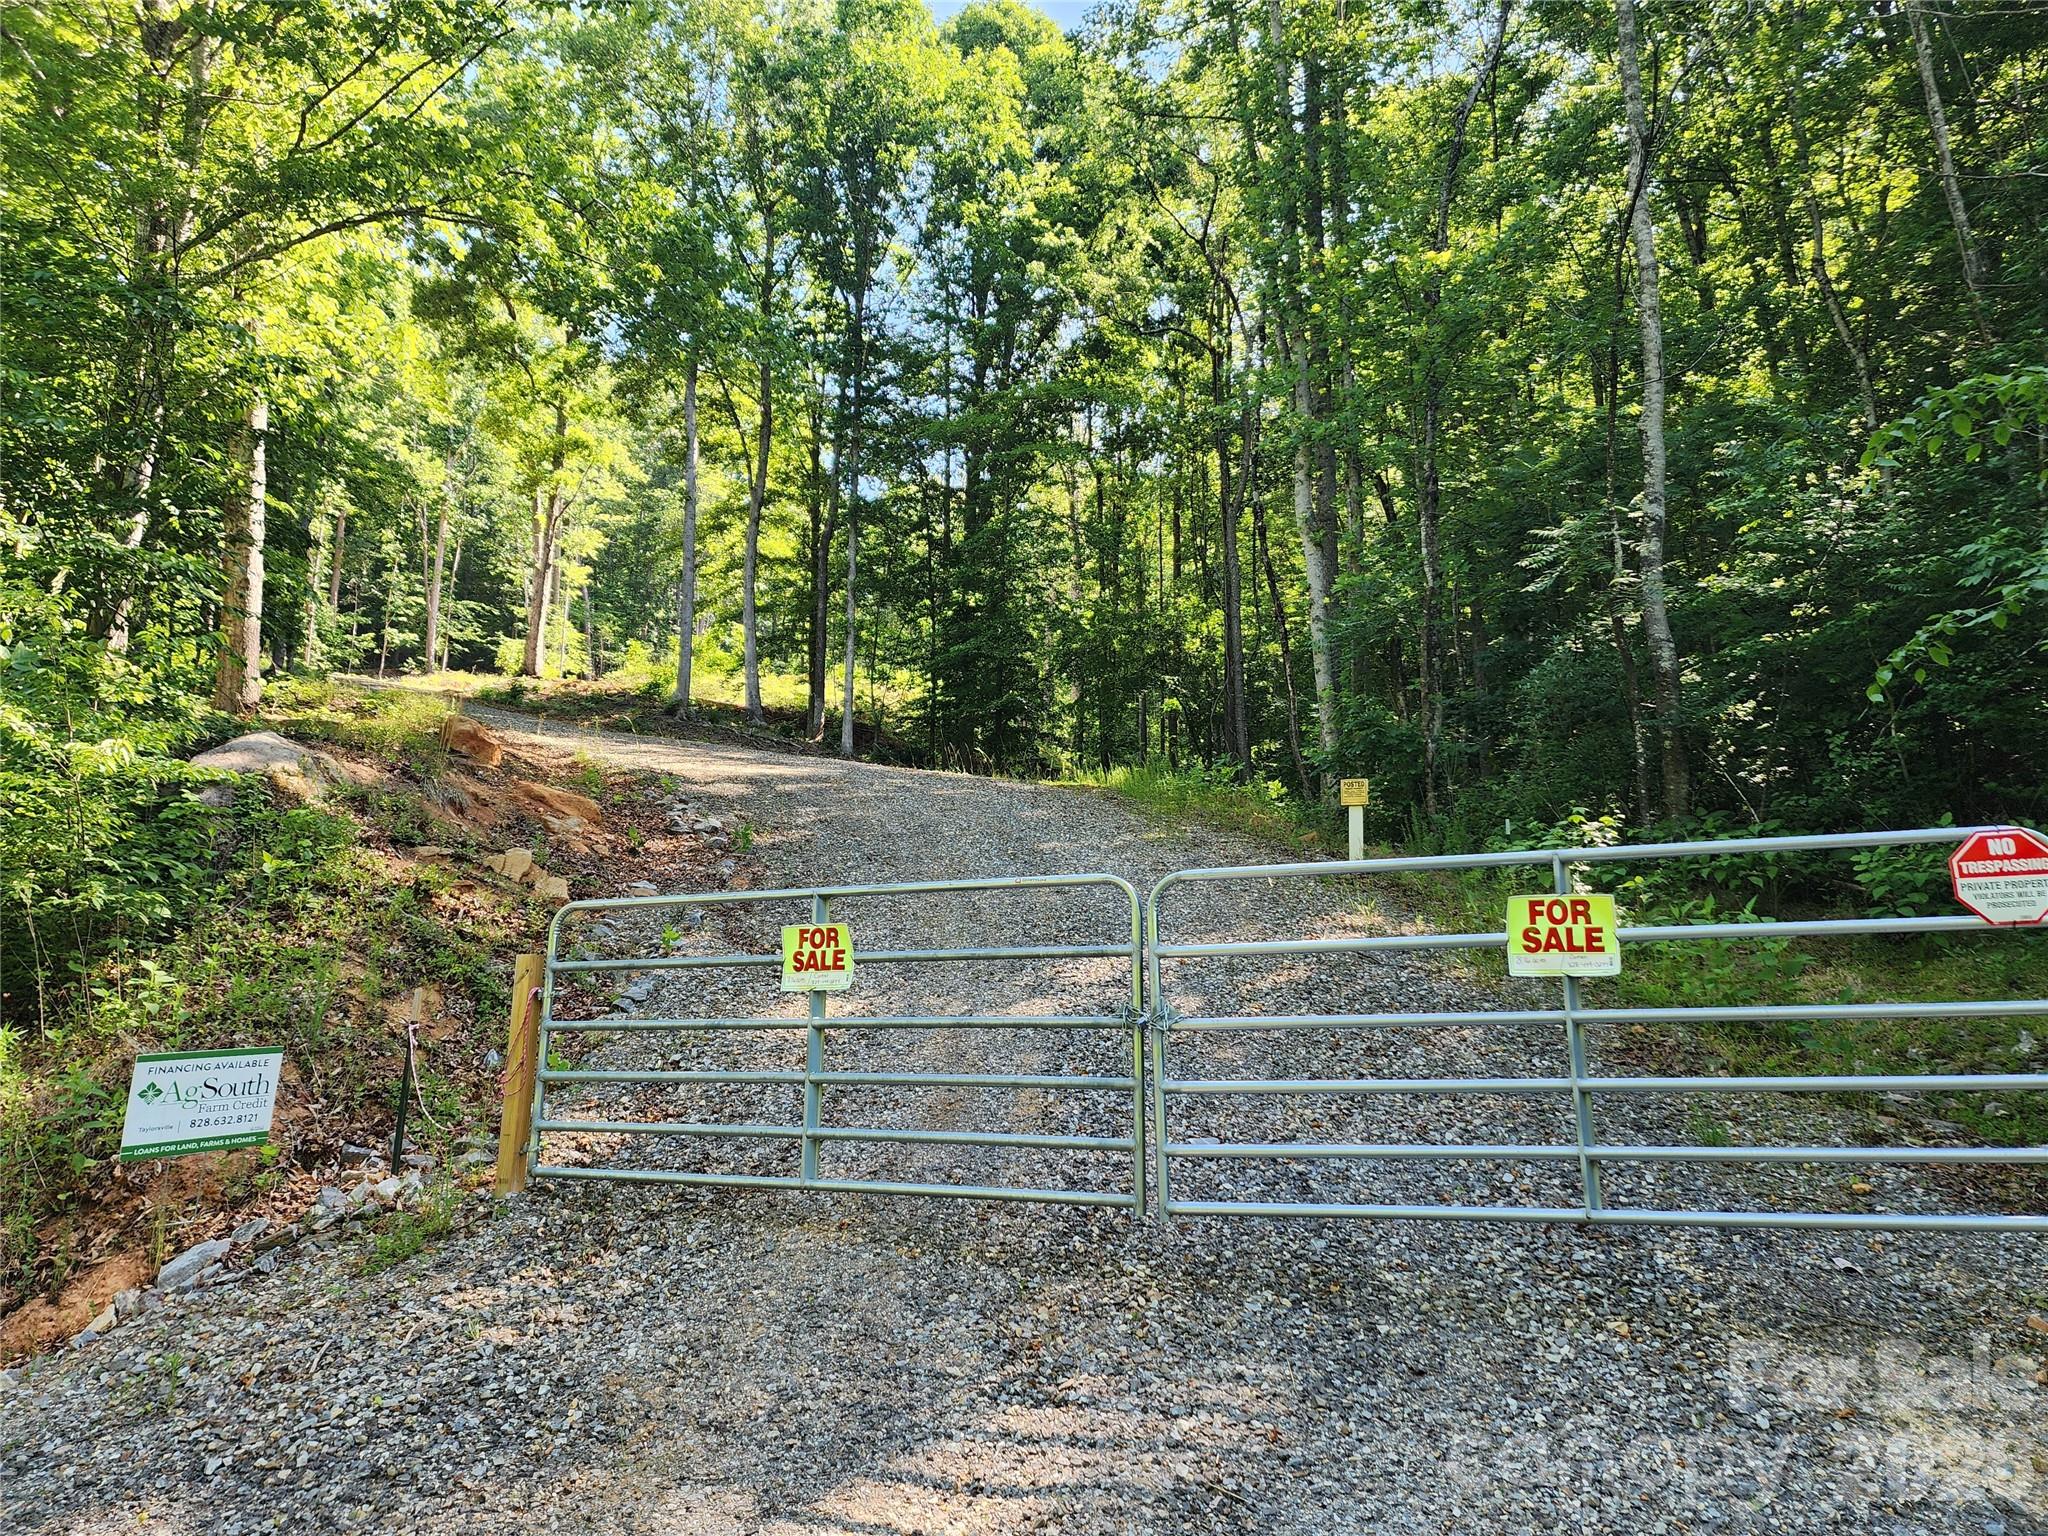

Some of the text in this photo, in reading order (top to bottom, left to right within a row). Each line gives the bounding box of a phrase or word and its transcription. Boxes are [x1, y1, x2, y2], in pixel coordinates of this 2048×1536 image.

[1986, 837, 2017, 856] NO
[1961, 879, 2048, 891] PRIVATE PROPERT
[1973, 889, 2047, 900] VIOLATORS WILL BE
[1528, 899, 1592, 925] FOR
[798, 927, 840, 949] FOR
[1521, 926, 1606, 953] SALE
[792, 949, 846, 972] SALE
[147, 1059, 270, 1075] FINANCING AVAILABLE
[161, 1073, 270, 1109] AgSouth
[197, 1099, 267, 1114] Farm Credit
[189, 1113, 258, 1129] 828.632.8121
[133, 1146, 160, 1156] LOANS
[160, 1144, 177, 1152] FOR
[177, 1141, 199, 1151] LAND,
[200, 1138, 224, 1148] FARMS
[231, 1135, 257, 1144] HOMES
